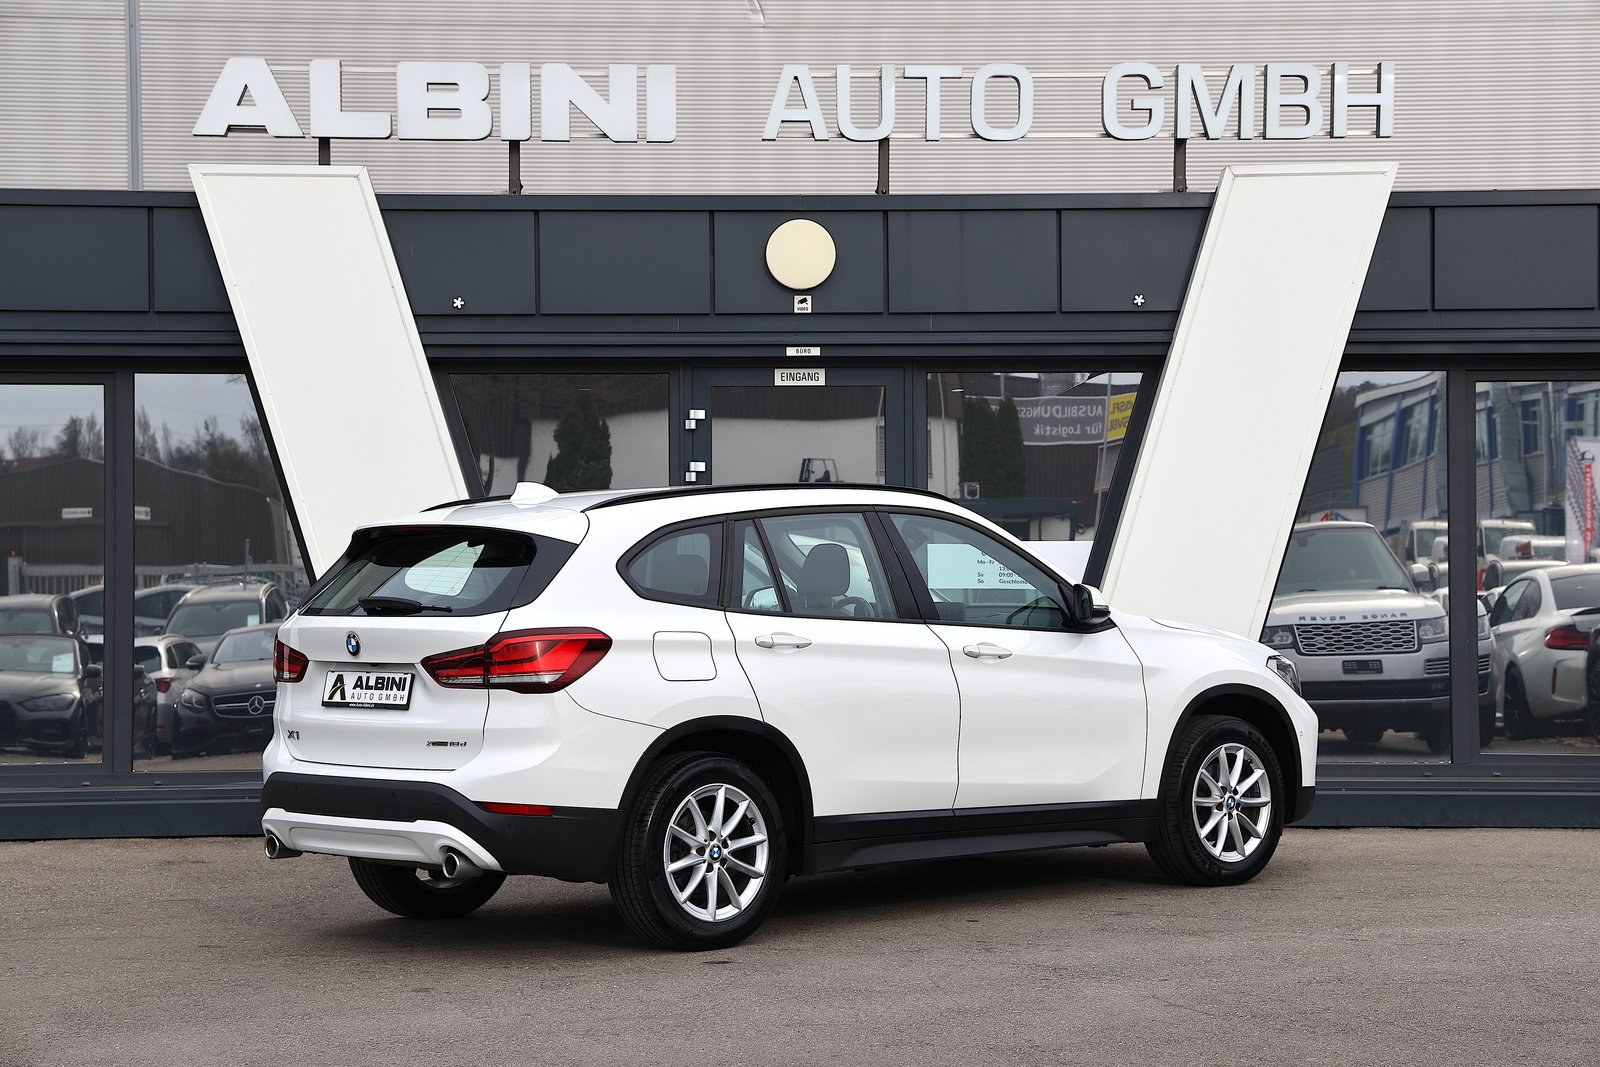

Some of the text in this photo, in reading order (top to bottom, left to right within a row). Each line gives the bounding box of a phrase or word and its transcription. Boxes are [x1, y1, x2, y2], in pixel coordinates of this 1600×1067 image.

[192, 57, 1396, 143] ALBINI AUTO GMBH
[780, 372, 820, 382] EINGANG
[352, 675, 408, 692] ALBINI
[350, 692, 405, 702] AUTO GMBH
[287, 729, 300, 740] X1
